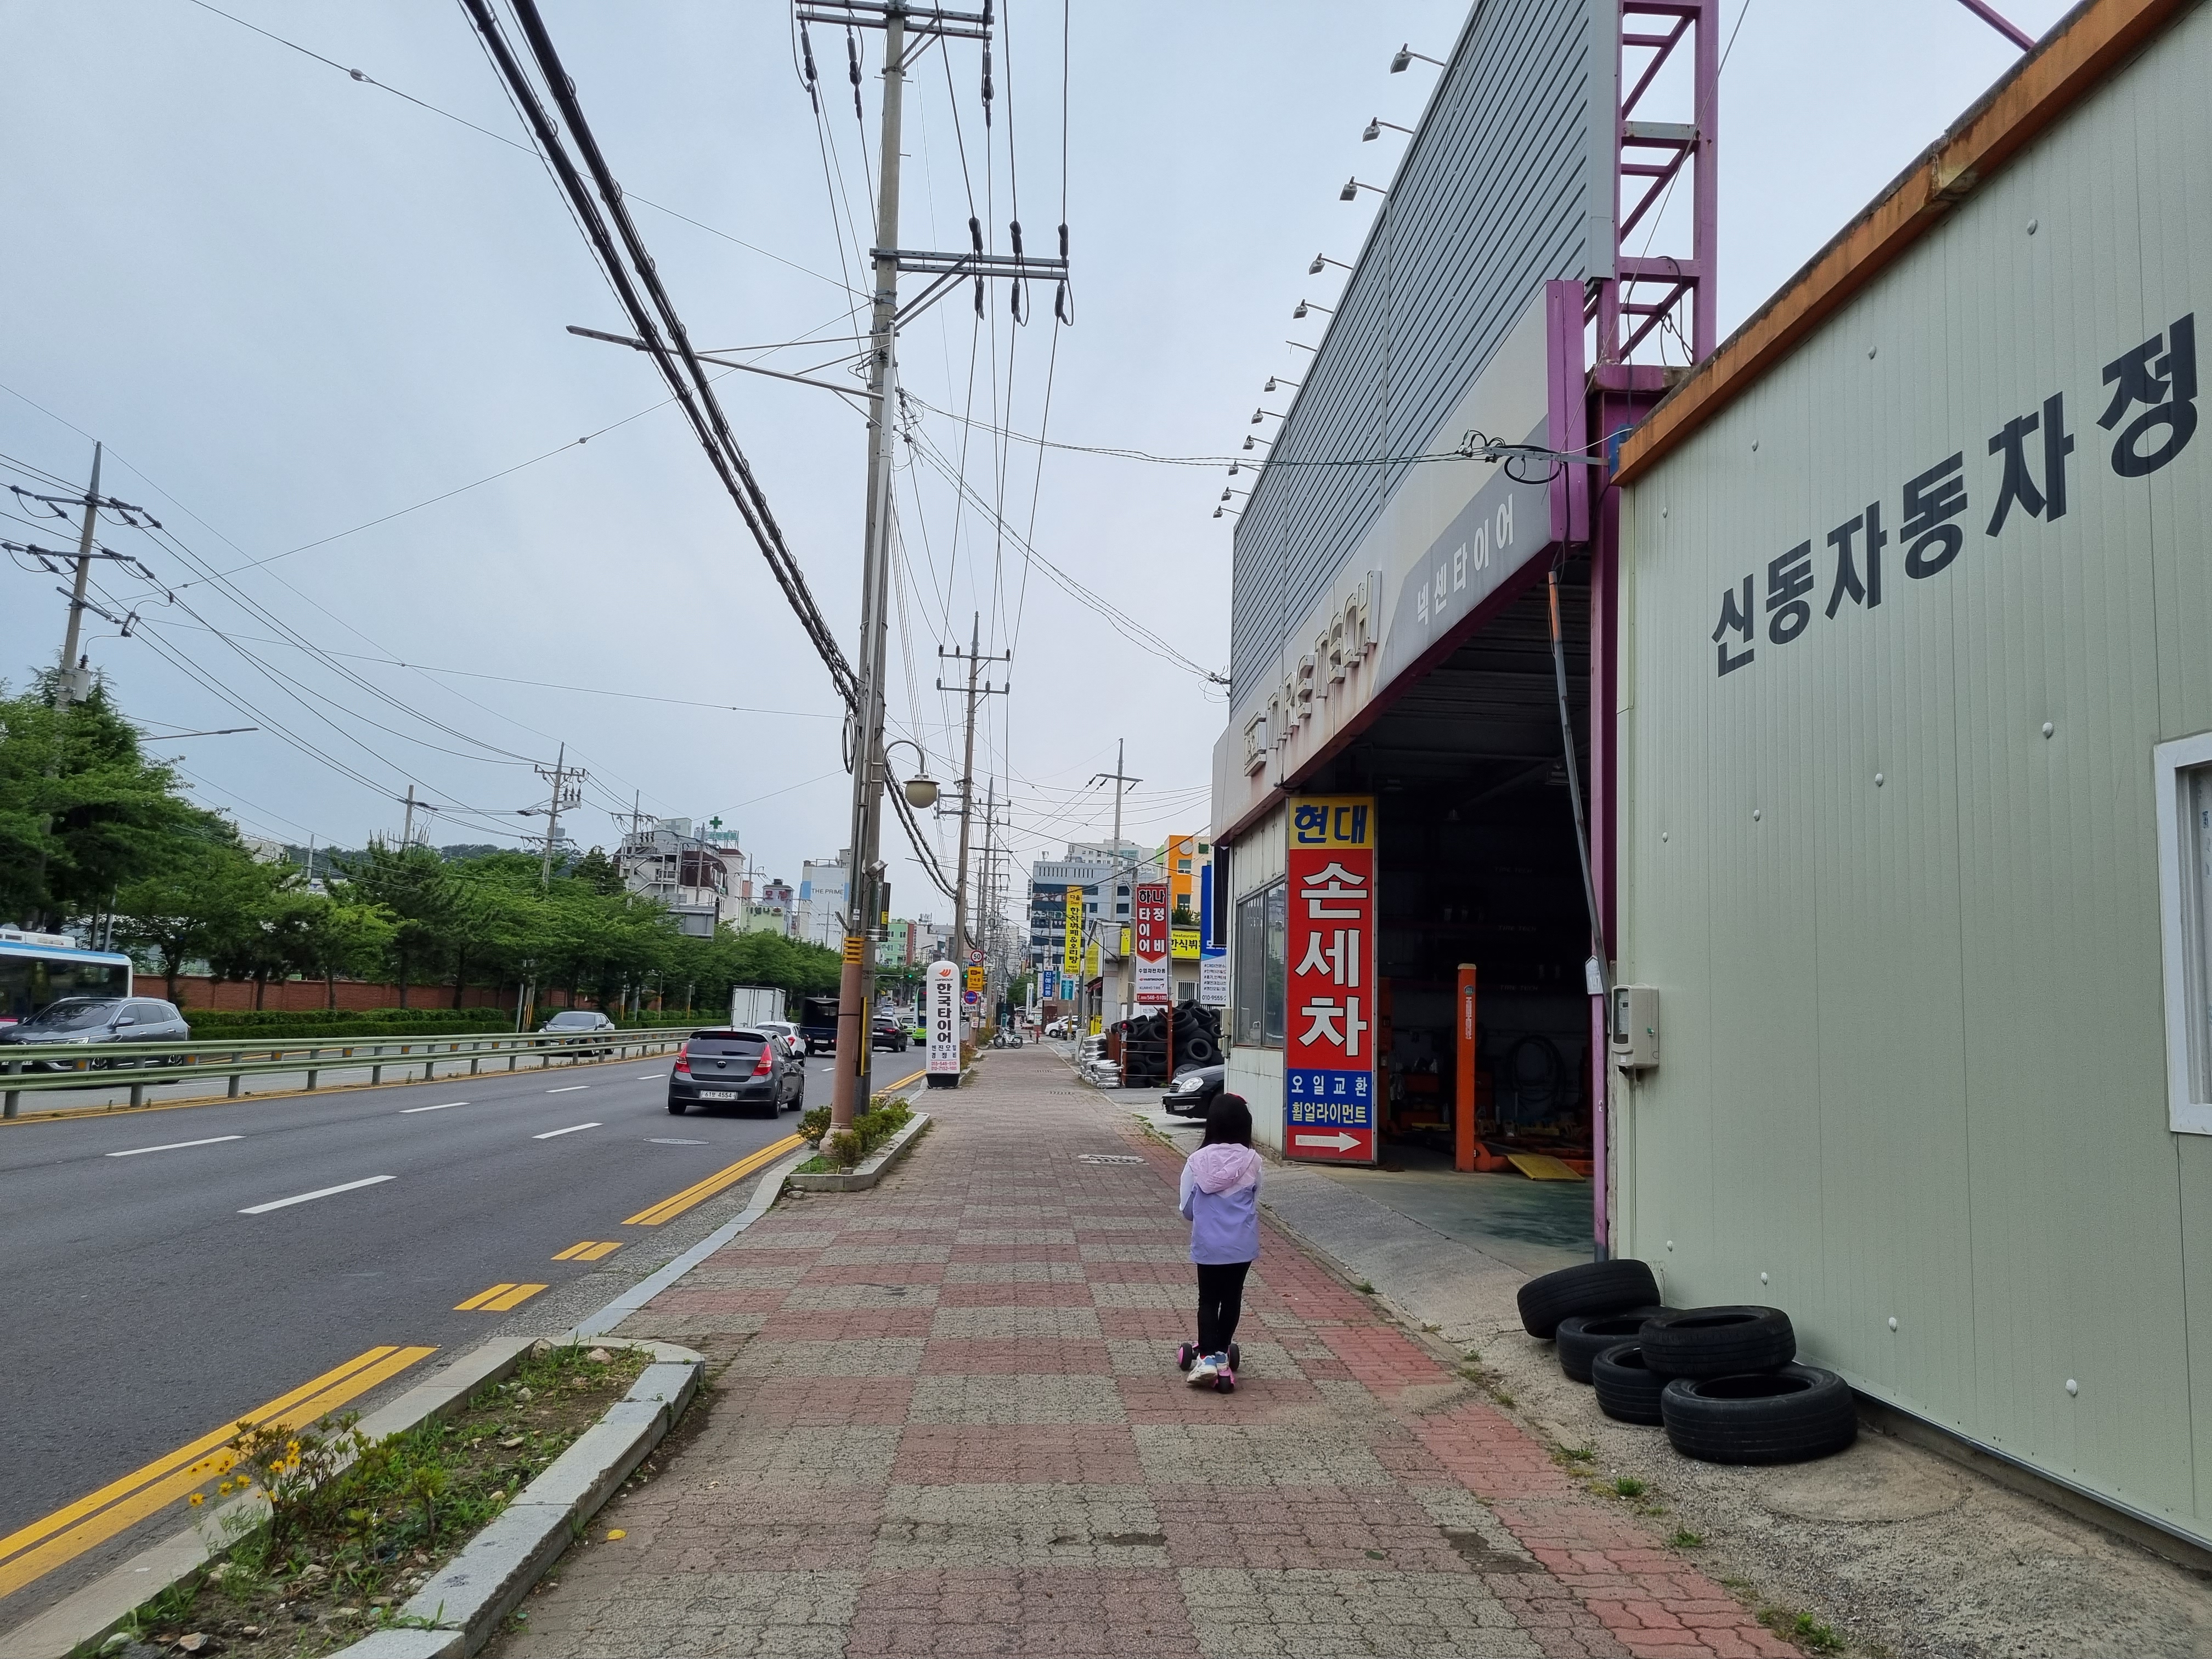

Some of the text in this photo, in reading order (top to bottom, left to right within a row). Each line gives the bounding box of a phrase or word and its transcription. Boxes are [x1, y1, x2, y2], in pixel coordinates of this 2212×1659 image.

[1711, 312, 2198, 678] 신동자동차정
[1417, 494, 1514, 625] 넥센타이어
[1294, 804, 1368, 844] 현대
[1138, 890, 1165, 904] 하나
[1138, 908, 1151, 952] 타이어
[1153, 908, 1165, 953] 정비
[1294, 861, 1368, 1057] 손세차
[936, 983, 952, 1043] 한국타이어
[1291, 1075, 1367, 1097] 오일교환
[1292, 1102, 1367, 1124] 휠얼라이먼트
